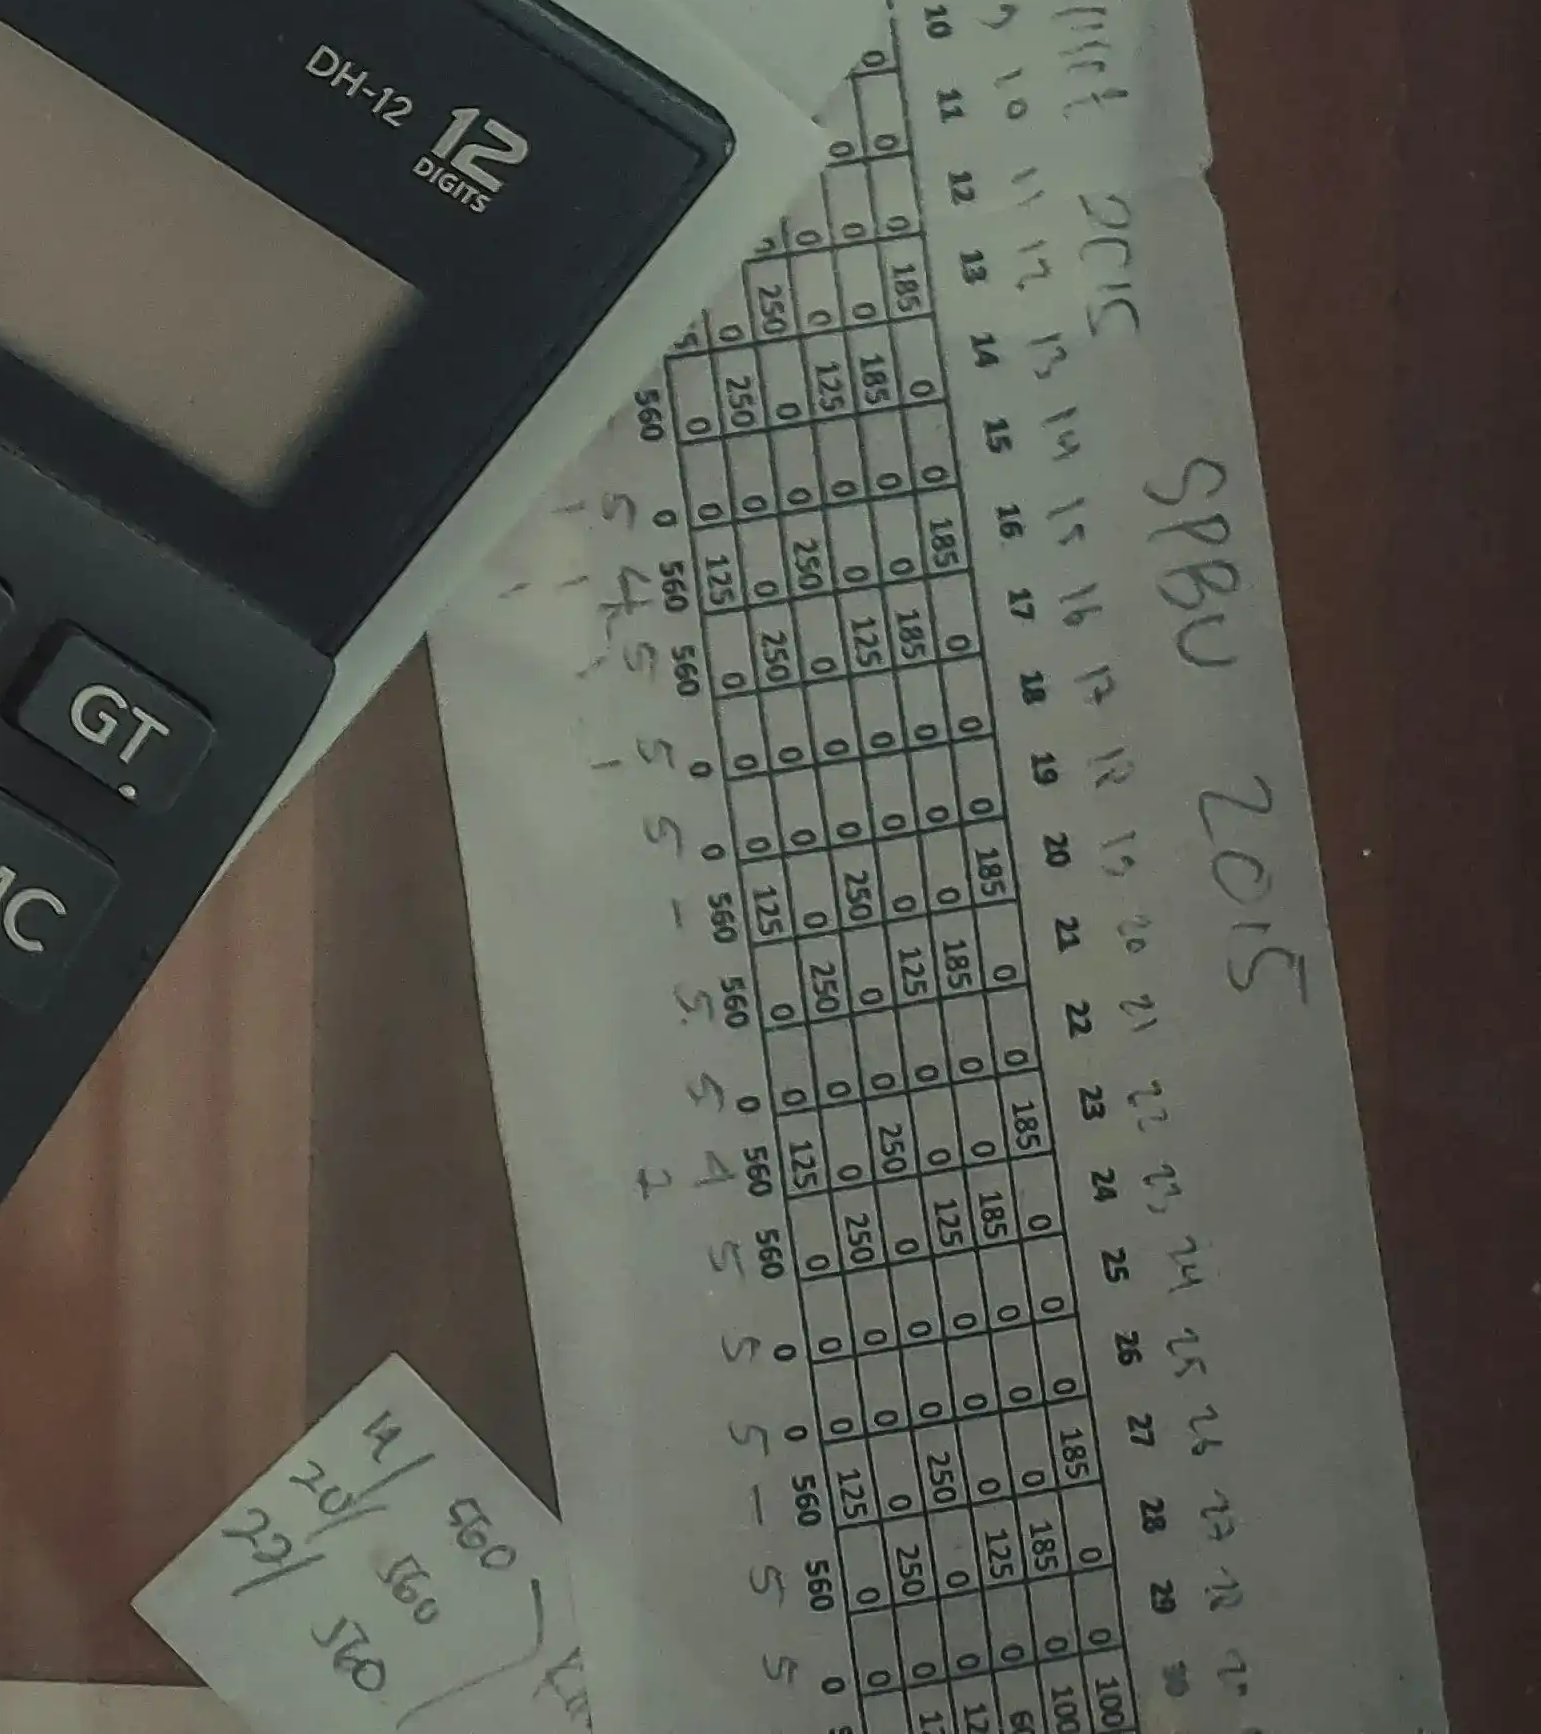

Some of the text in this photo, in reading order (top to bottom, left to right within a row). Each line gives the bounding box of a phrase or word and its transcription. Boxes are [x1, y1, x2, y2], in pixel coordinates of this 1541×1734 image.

[923, 4, 953, 39] 10
[305, 45, 528, 193] DH-12 12
[936, 88, 965, 124] 11
[412, 157, 492, 213] DIGITS
[947, 170, 976, 206] 12
[959, 249, 988, 286] 13
[969, 333, 1000, 369] 14
[634, 388, 665, 442] 560
[983, 418, 1013, 454] 15
[995, 503, 1024, 540] 16
[929, 518, 960, 568] 185
[658, 560, 689, 613] 560
[1007, 587, 1036, 621] 17
[71, 685, 170, 764] GT
[1030, 751, 1059, 787] 19
[1043, 832, 1072, 868] 20
[974, 847, 1007, 897] 185
[844, 870, 873, 922] 250
[1198, 775, 1308, 1007] 2015
[707, 891, 739, 944] 560
[752, 884, 784, 937] 125
[1054, 915, 1081, 953] 21
[1065, 1000, 1093, 1040] 22
[1078, 1084, 1106, 1121] 23
[1090, 1167, 1118, 1203] 24
[1101, 1246, 1130, 1283] 25
[1114, 1330, 1143, 1367] 26
[1126, 1412, 1156, 1447] 27
[1139, 1497, 1167, 1535] 28
[1149, 1578, 1177, 1615] 29
